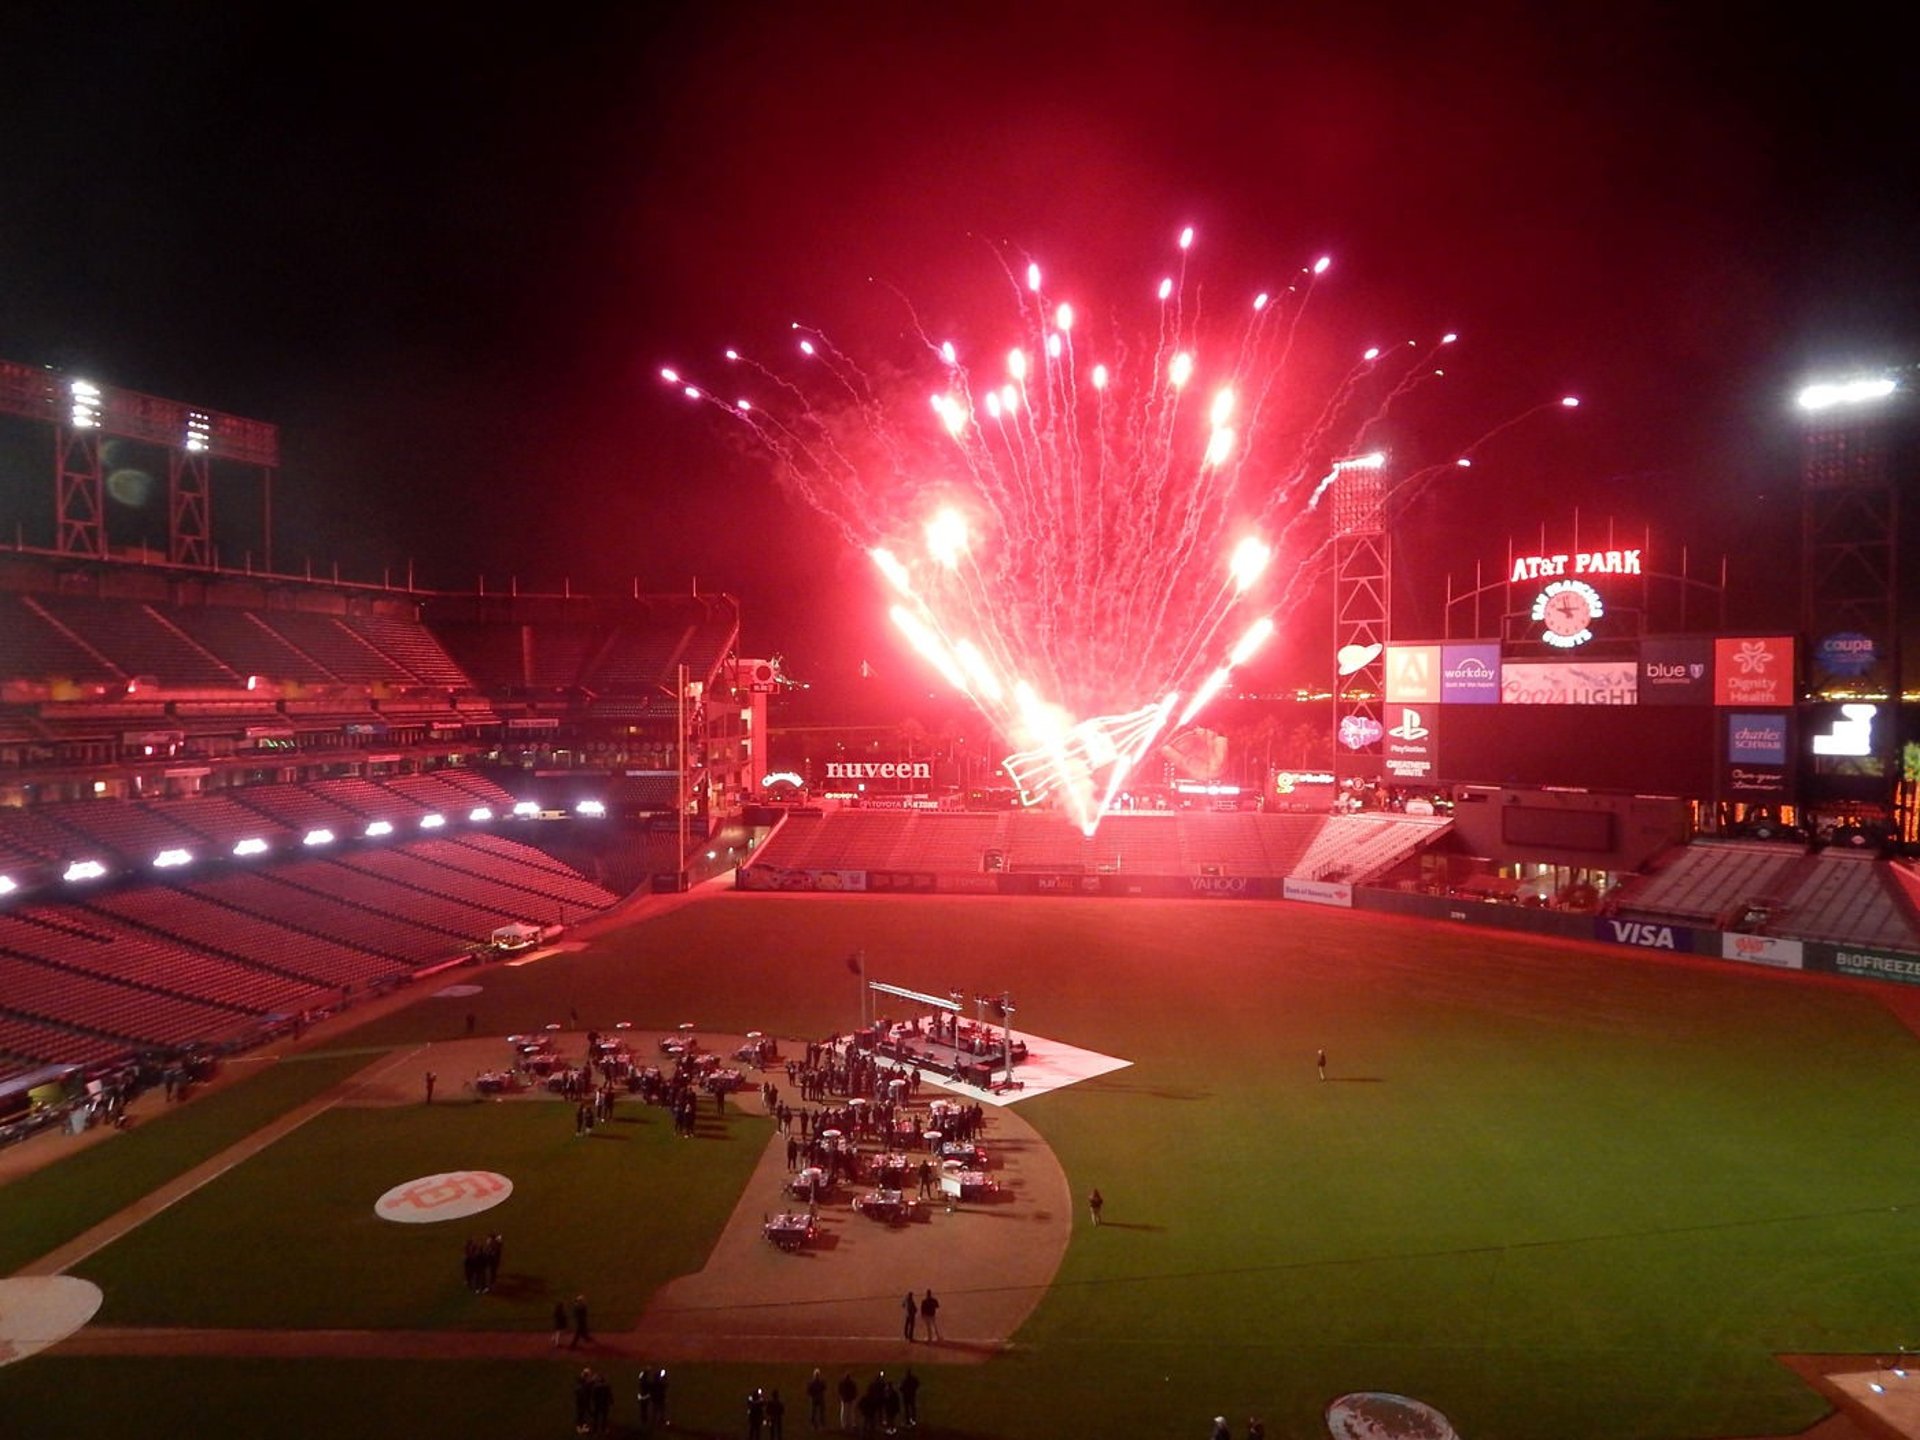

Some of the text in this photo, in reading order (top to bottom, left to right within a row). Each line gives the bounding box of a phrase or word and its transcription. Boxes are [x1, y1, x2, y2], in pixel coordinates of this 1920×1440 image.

[1510, 549, 1641, 582] AT&T PARK
[1824, 639, 1873, 653] coupa
[1444, 667, 1495, 680] workday
[1647, 663, 1686, 677] blue
[1728, 677, 1777, 691] Dignity
[1502, 681, 1637, 704] Coors LIGHT
[1730, 692, 1776, 702] Health
[826, 762, 931, 779] nuveen
[1190, 876, 1247, 892] YAHOO!
[1608, 920, 1675, 949] VISA
